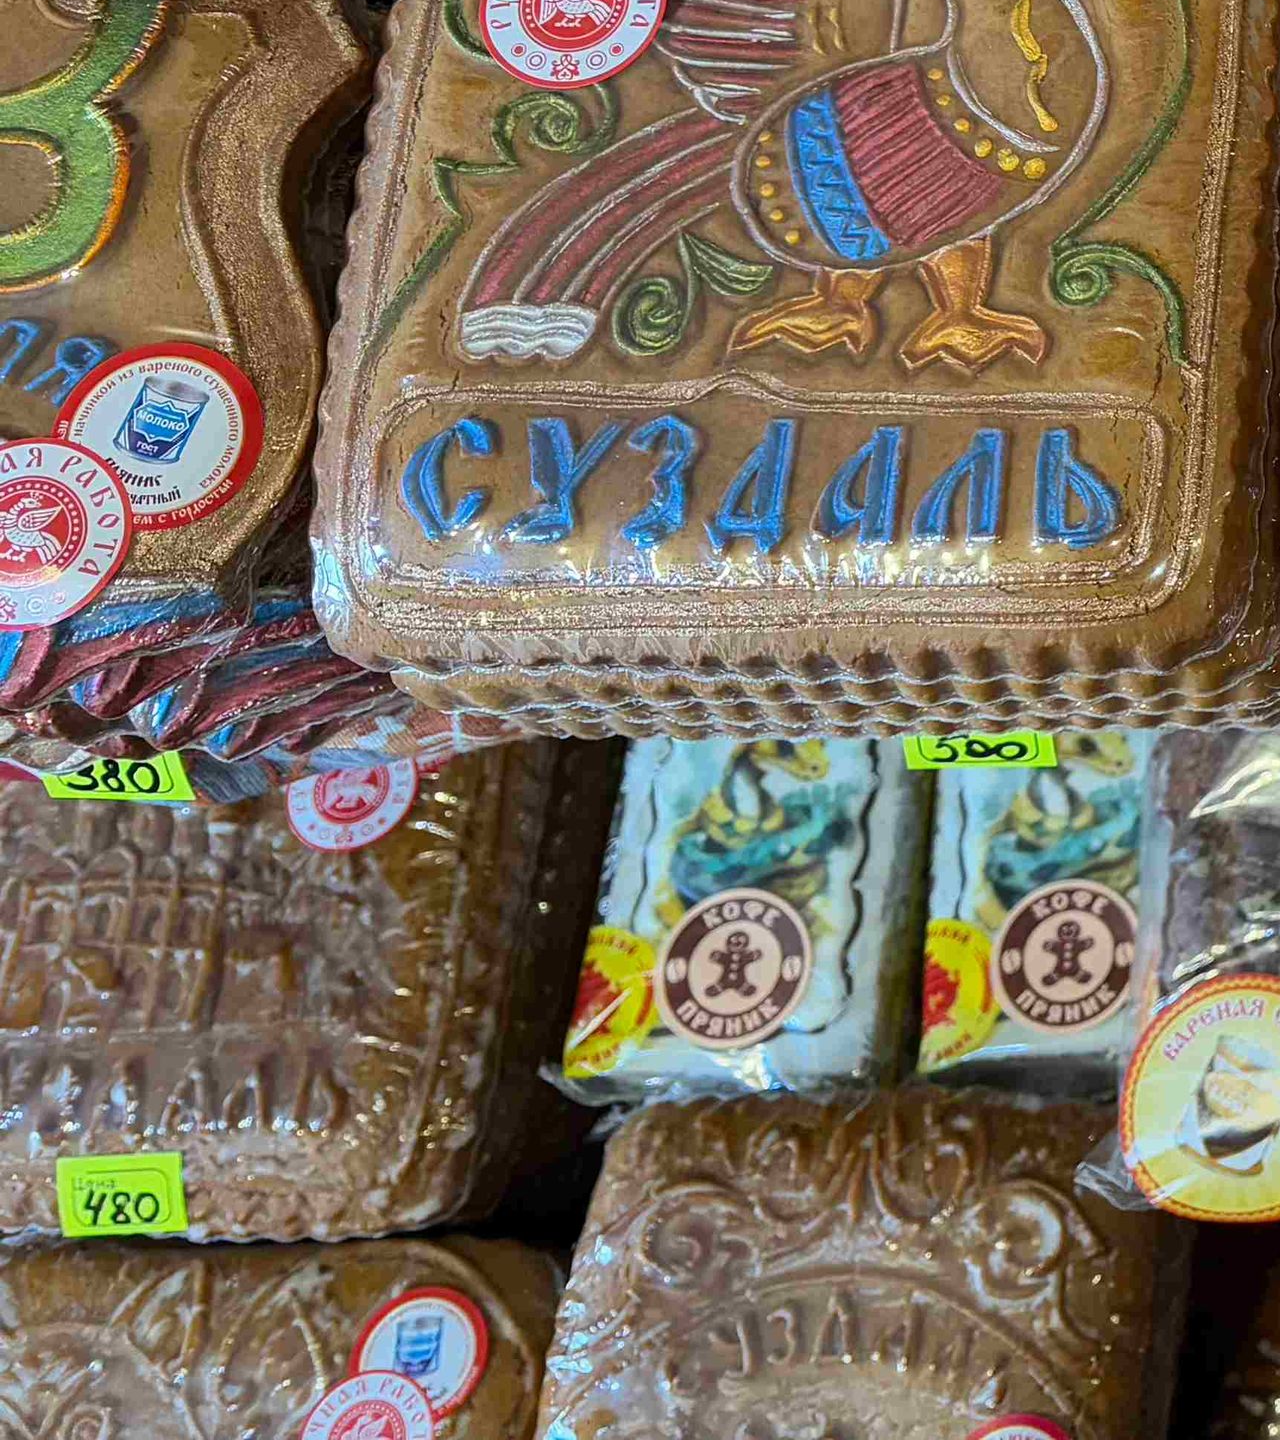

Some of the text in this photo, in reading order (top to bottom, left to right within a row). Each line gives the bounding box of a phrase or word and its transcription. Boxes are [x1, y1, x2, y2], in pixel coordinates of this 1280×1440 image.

[136, 410, 186, 433] МОЛОКО
[127, 486, 182, 506] ЧАТНЫЙ
[401, 413, 1123, 557] СУЗДАЛЬ
[60, 453, 120, 578] РАБОТА
[932, 736, 1027, 764] 500
[66, 758, 162, 794] 380
[701, 899, 782, 930] КОФЕ
[1031, 889, 1110, 920] КОФЕ
[676, 997, 781, 1038] ПРЯНИК
[1016, 981, 1117, 1024] ПРЯНИК
[1160, 998, 1266, 1063] ВАРЕНАЯ
[83, 1189, 161, 1227] 480
